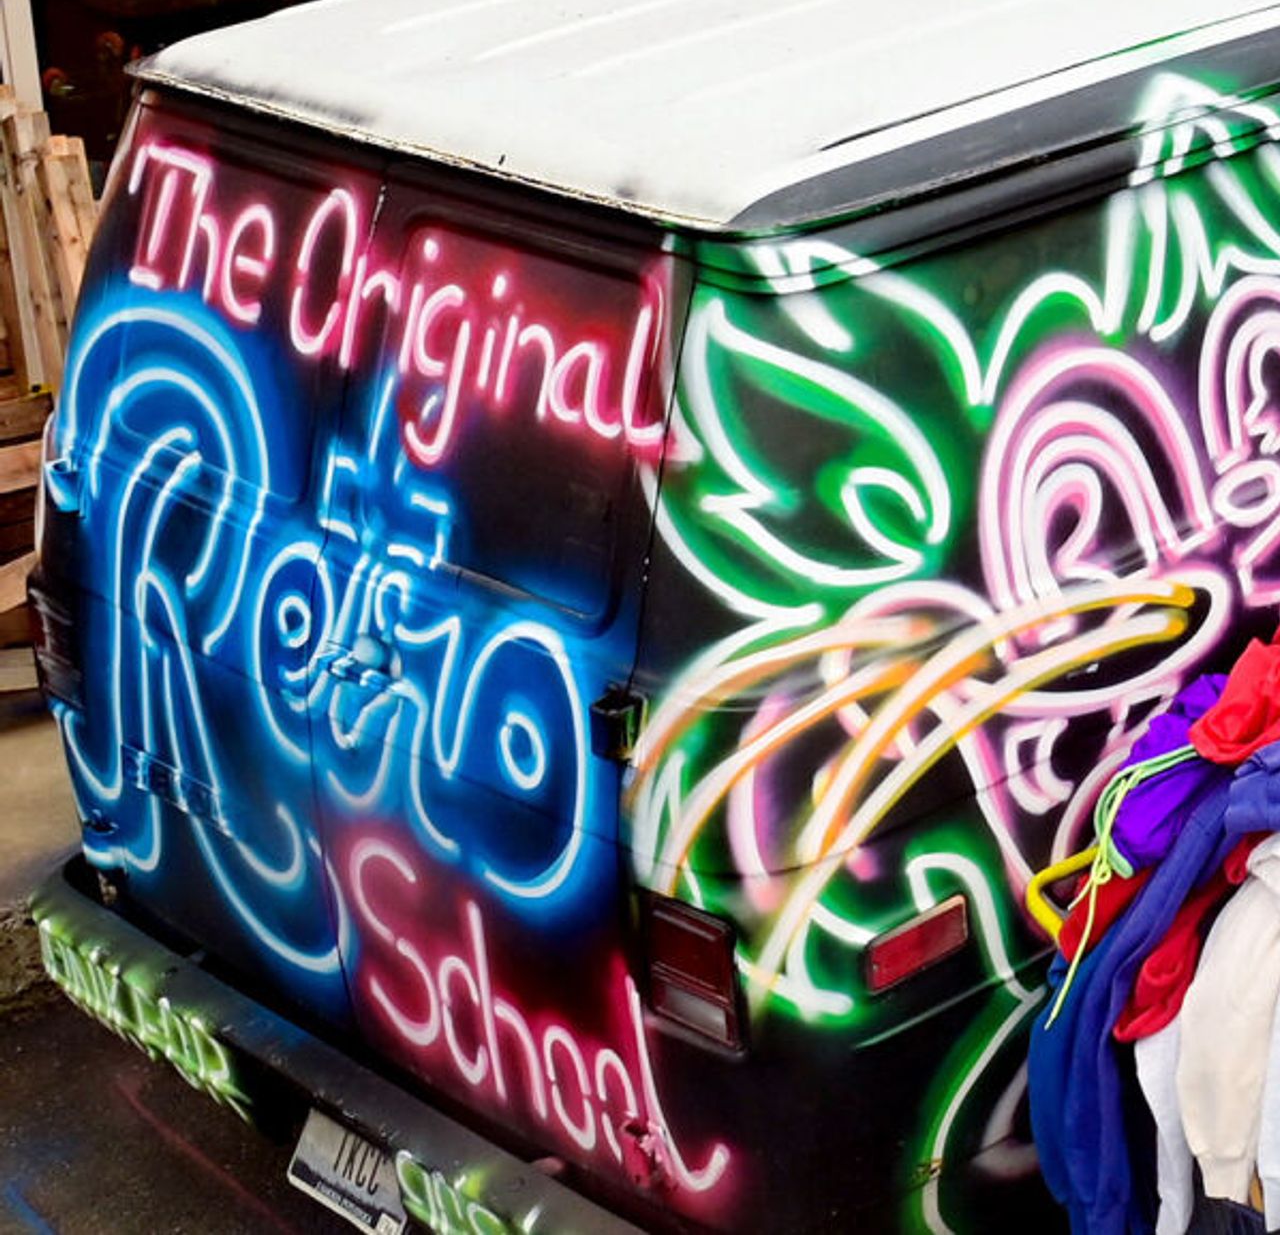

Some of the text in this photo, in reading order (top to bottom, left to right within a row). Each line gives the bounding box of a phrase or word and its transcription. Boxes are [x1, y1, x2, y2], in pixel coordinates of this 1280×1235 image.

[128, 142, 668, 464] The Original
[350, 836, 730, 1192] School
